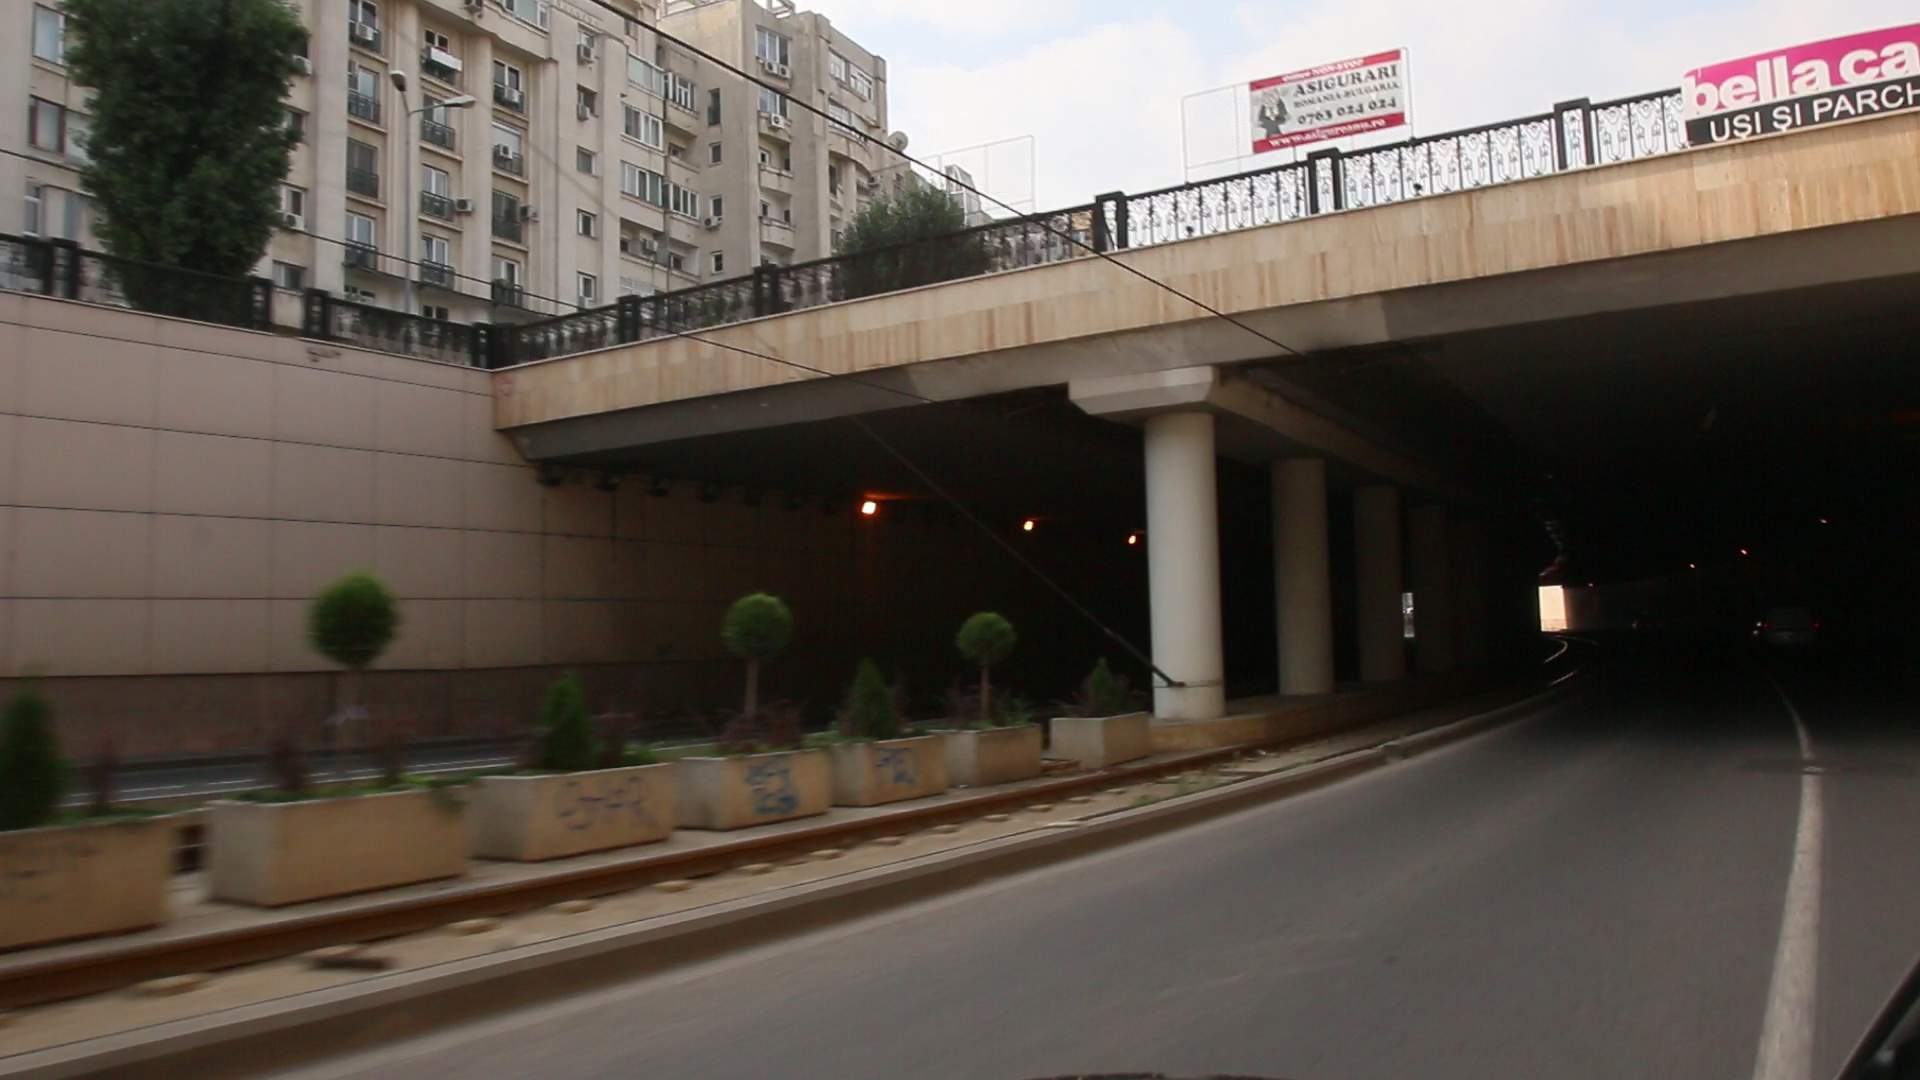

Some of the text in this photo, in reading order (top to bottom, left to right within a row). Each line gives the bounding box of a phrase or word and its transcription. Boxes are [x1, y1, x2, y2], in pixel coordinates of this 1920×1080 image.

[1294, 64, 1397, 97] ASIGURARI
[1681, 55, 1832, 117] bella
[1298, 97, 1397, 125] 0763 024 024
